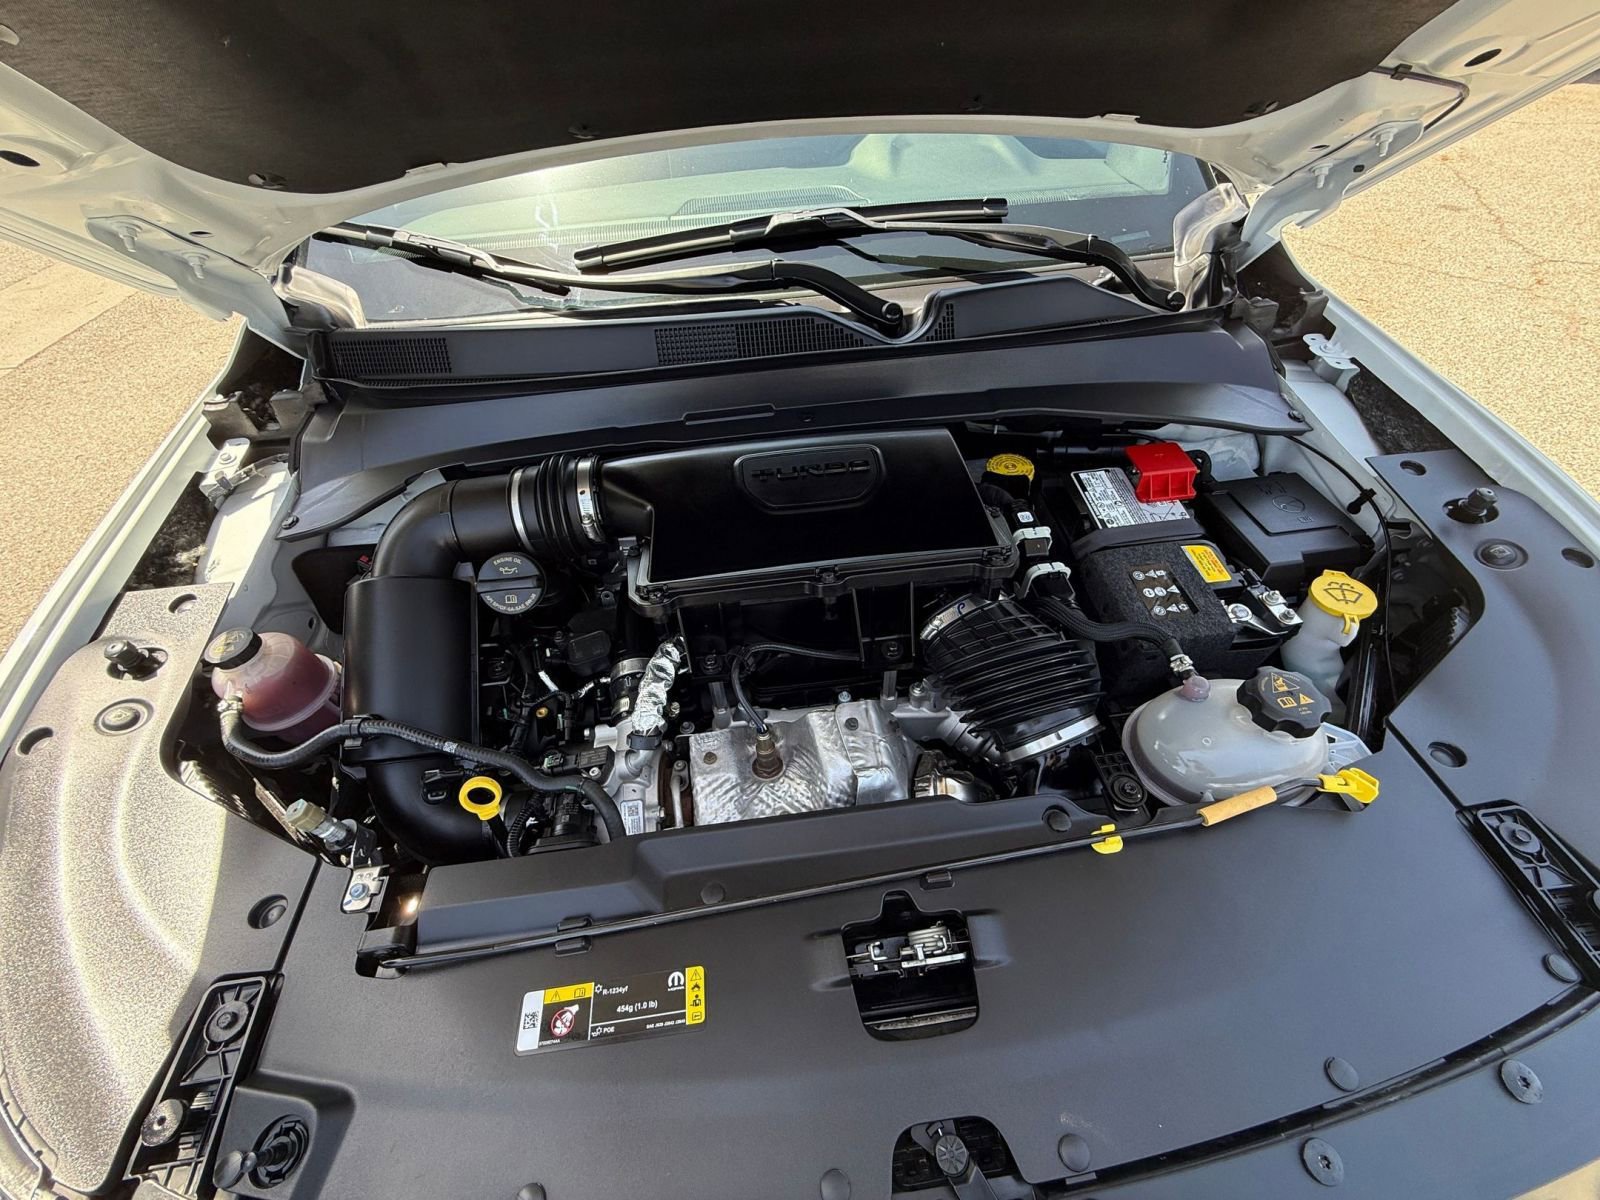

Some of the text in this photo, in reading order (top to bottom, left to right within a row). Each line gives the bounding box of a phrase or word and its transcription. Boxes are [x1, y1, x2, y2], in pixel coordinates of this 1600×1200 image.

[751, 460, 871, 482] TURBO
[493, 556, 522, 566] ENGINE OIL
[602, 985, 629, 996] R-1234yf
[616, 1000, 658, 1013] 454g (1.0 lb)
[603, 1026, 615, 1034] POE
